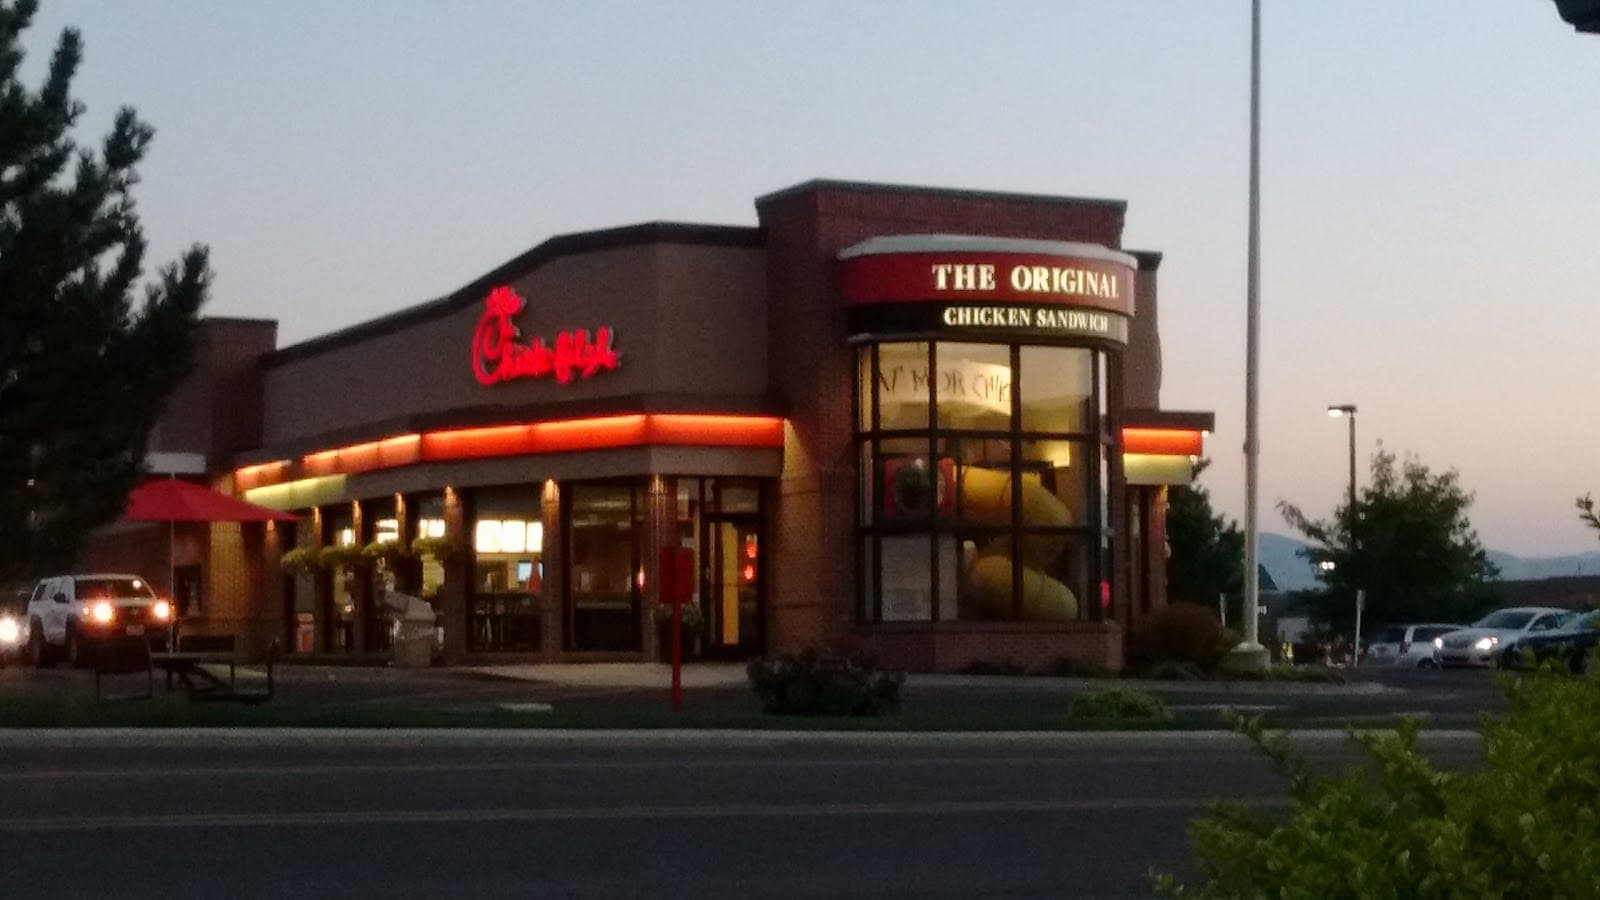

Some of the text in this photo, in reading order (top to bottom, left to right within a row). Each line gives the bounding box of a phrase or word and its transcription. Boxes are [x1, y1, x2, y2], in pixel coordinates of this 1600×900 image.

[932, 264, 1118, 298] THE ORIGINAL
[943, 306, 1109, 332] CHICKEN SANDWICH
